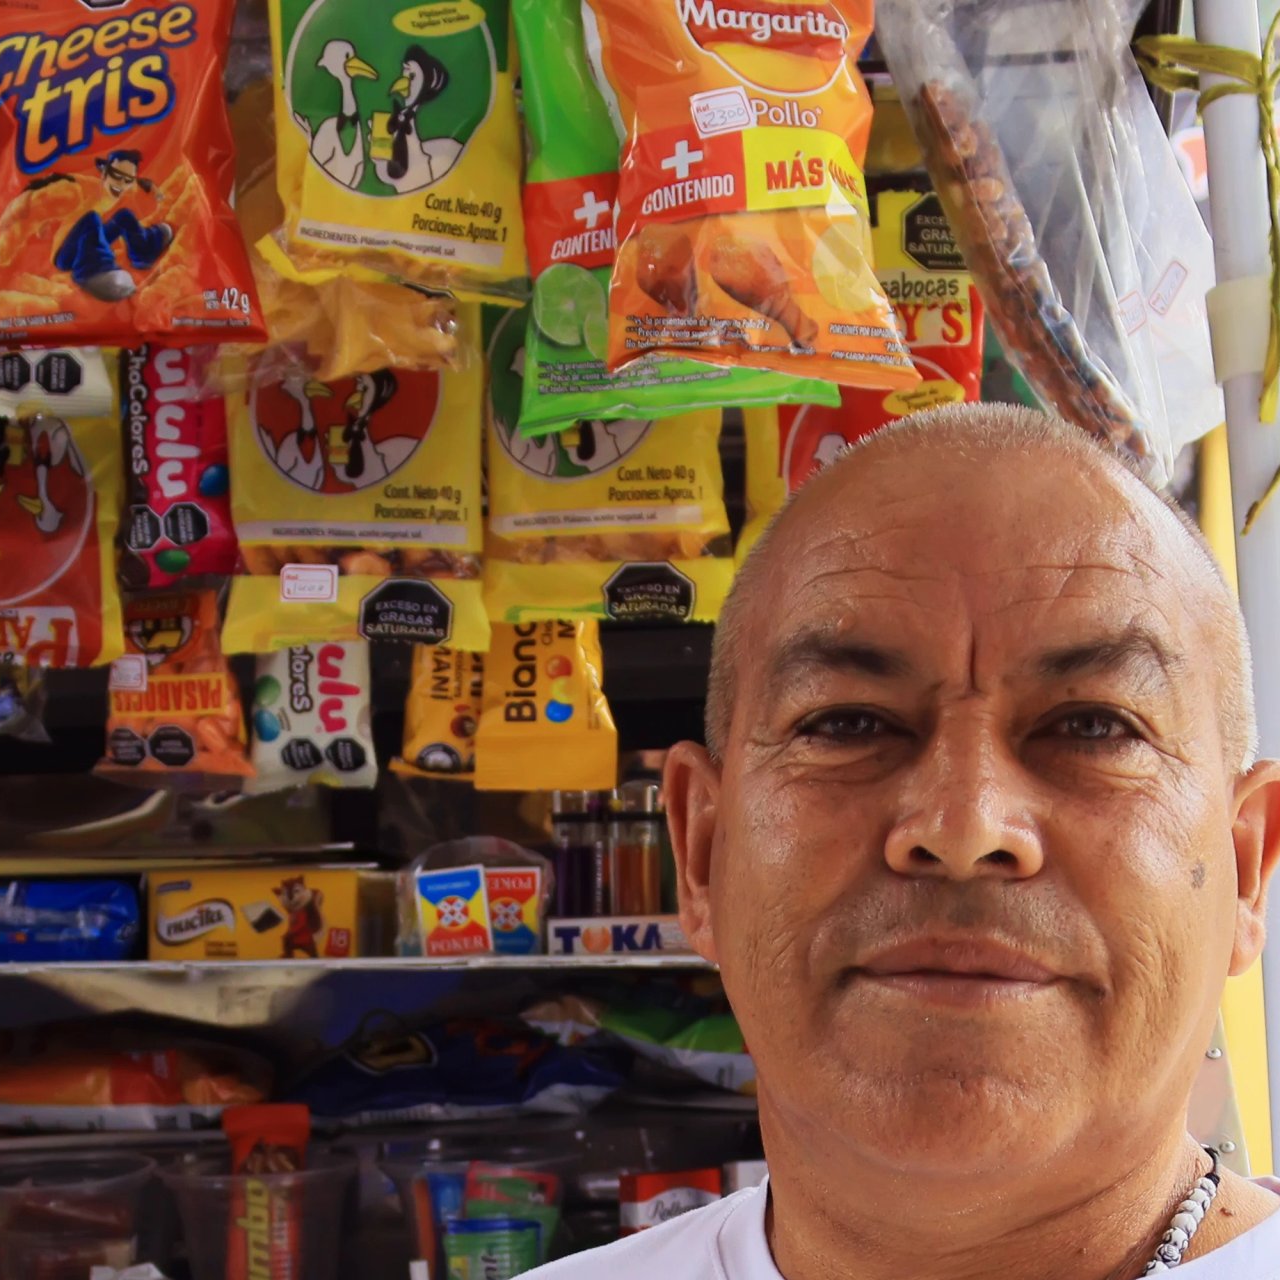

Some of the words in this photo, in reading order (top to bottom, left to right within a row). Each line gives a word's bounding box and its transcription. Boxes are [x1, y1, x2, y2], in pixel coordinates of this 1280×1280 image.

[682, 0, 848, 41] Margarita
[22, 54, 169, 164] tris
[750, 98, 819, 128] Pollo
[765, 150, 825, 192] MÁS
[640, 173, 735, 216] CONTENIDO
[425, 193, 453, 212] Cont.
[455, 197, 479, 217] Neto
[479, 202, 494, 218] 40
[494, 207, 503, 223] g
[411, 213, 465, 236] Porciones:
[467, 222, 499, 243] Aprox.
[501, 226, 508, 243] 1
[916, 214, 950, 226] EXCE
[646, 465, 672, 481] Neto
[673, 464, 687, 480] 40
[412, 485, 439, 500] Neto
[375, 600, 421, 613] EXCESO
[422, 602, 439, 614] EN
[611, 601, 687, 615] SATURADAS
[379, 611, 434, 626] GRASAS
[365, 625, 446, 638] SATURADAS
[166, 907, 224, 937] nucita
[330, 929, 348, 948] 18
[429, 936, 485, 954] POKER
